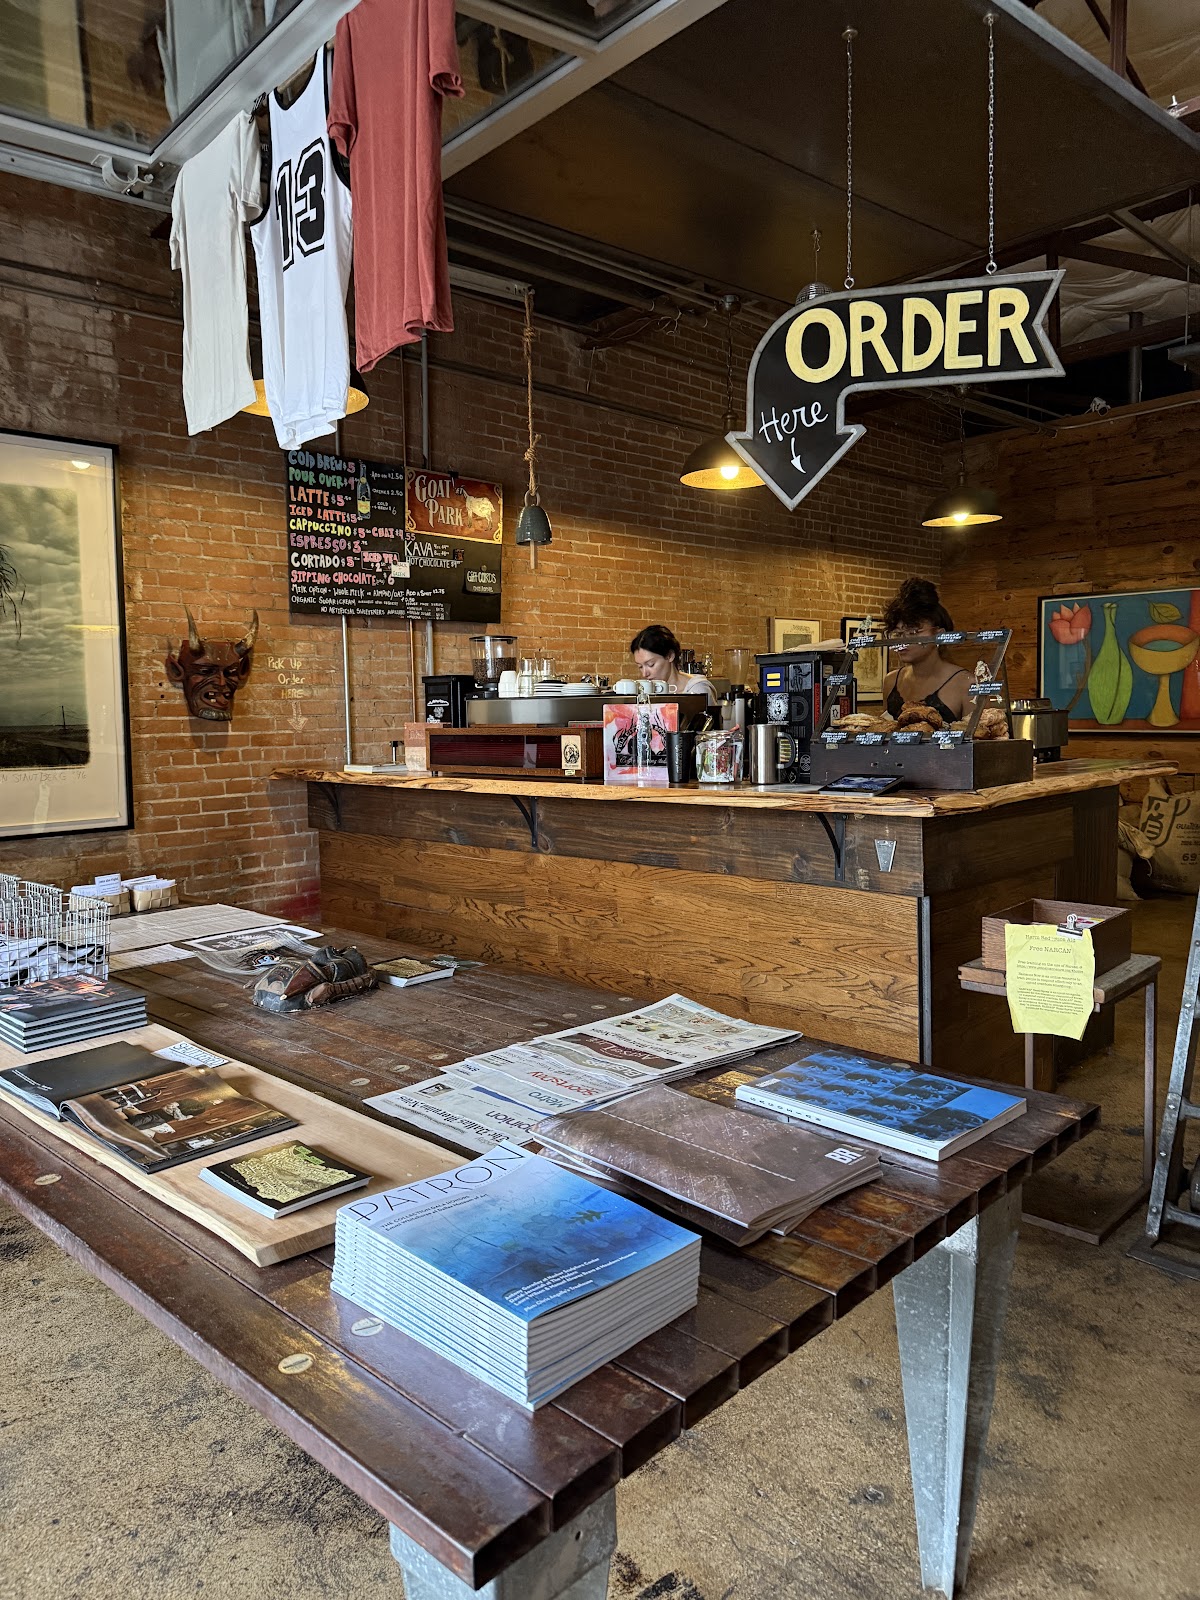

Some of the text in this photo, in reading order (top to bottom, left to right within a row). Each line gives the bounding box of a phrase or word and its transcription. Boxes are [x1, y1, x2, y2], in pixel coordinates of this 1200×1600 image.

[275, 137, 325, 272] 13
[785, 287, 1037, 384] ORDER
[758, 399, 829, 444] Here
[317, 453, 343, 471] BREW
[288, 467, 316, 485] POUR
[319, 473, 344, 489] OVER
[289, 485, 329, 507] LATTE
[415, 474, 452, 503] GOAT
[289, 504, 313, 517] ICED
[317, 508, 346, 523] LATTE
[425, 498, 464, 528] PARK
[289, 518, 352, 537] CAPPUCCINO
[372, 527, 394, 538] CHAI
[289, 533, 347, 553] ESPRESSO
[404, 540, 434, 557] KAVA
[290, 552, 340, 568] CORTADO
[405, 556, 418, 566] HOT
[418, 558, 450, 568] CHOCOLATE
[290, 570, 331, 585] SIPPING
[291, 595, 316, 603] ORGANIC
[267, 656, 302, 670] Pick Up
[278, 673, 305, 685] Order
[281, 689, 304, 699] HERE
[1044, 946, 1072, 954] NARCAN
[397, 1095, 421, 1109] News
[528, 1091, 569, 1108] Metro
[419, 1102, 459, 1123] Morning
[486, 1110, 535, 1133] pinion
[458, 1118, 491, 1136] Dallas
[348, 1145, 526, 1223] PATRON
